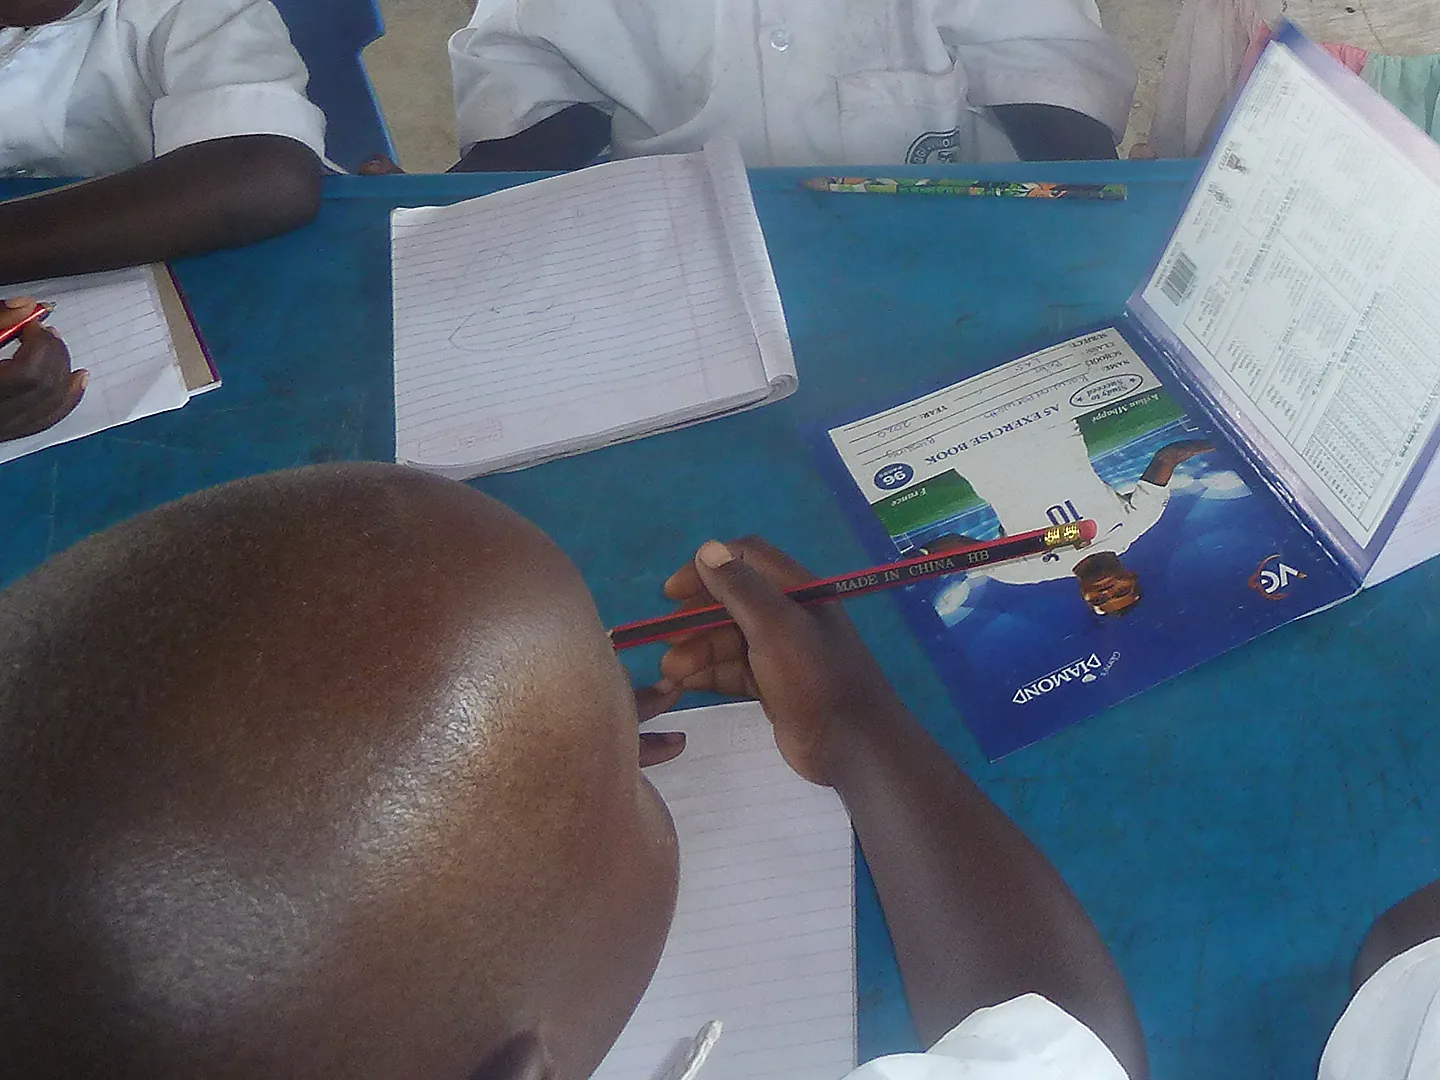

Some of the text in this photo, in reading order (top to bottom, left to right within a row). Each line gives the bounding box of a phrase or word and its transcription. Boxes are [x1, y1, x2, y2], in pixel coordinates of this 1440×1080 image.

[1086, 378, 1123, 397] Succeed
[1090, 384, 1127, 402] Study to
[919, 404, 947, 419] YEAR:
[923, 403, 1060, 466] A5 EXERCISE BOOK
[882, 470, 907, 487] 96
[890, 487, 927, 507] France
[834, 548, 990, 594] MADE IN CHINA HB
[1012, 652, 1102, 704] DIAMOND
